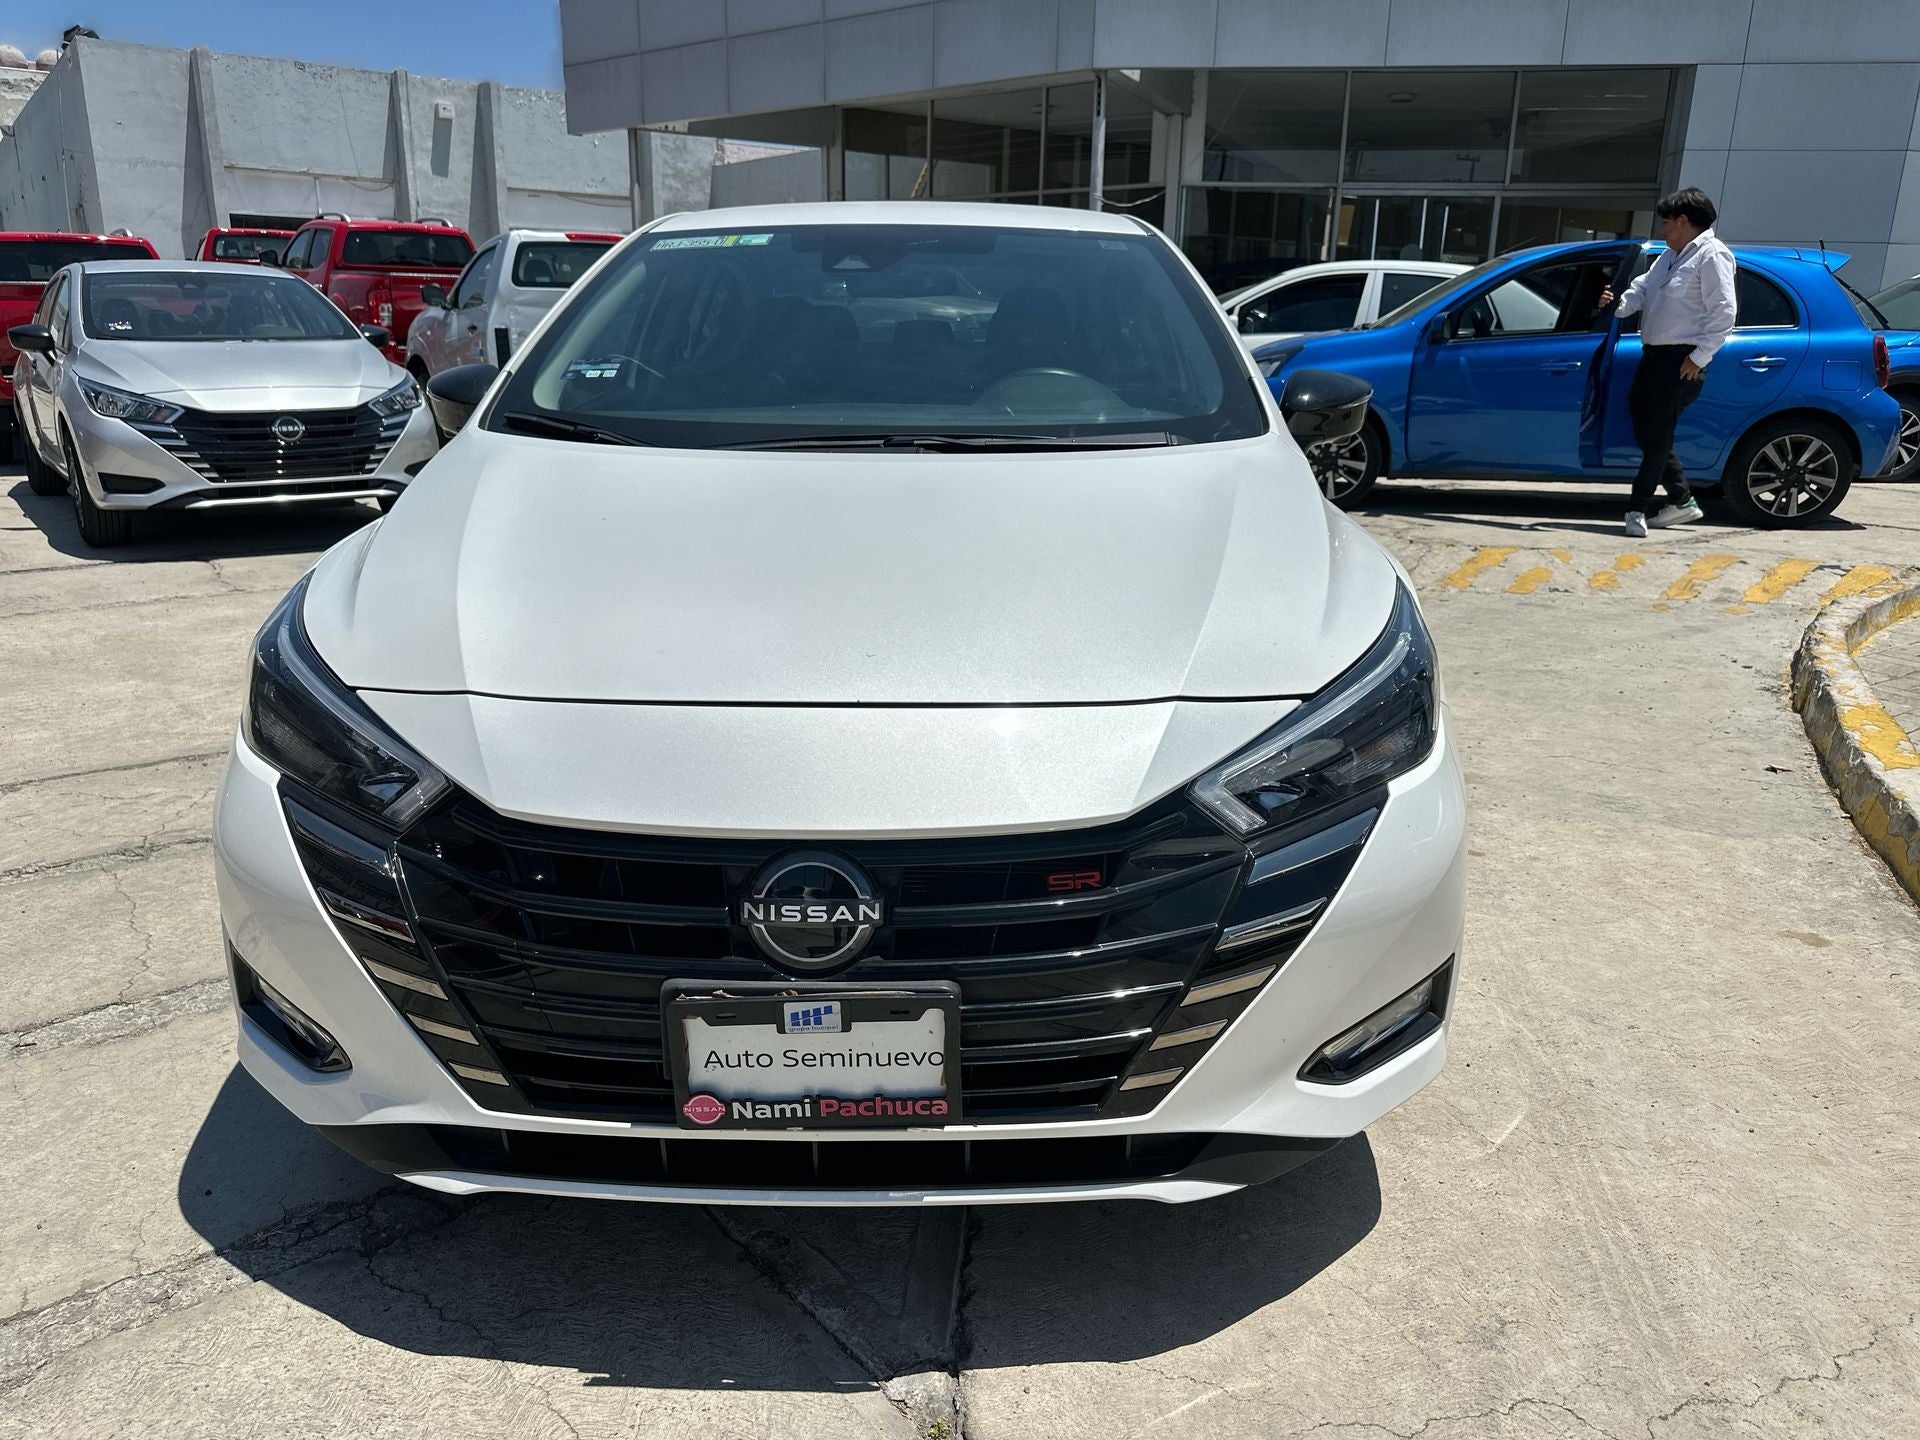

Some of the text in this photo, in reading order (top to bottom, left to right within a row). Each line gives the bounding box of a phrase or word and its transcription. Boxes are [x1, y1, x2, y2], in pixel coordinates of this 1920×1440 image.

[1047, 872, 1101, 891] SR
[743, 902, 881, 923] NISSAN
[704, 1048, 945, 1069] Auto Seminuevo
[683, 1105, 725, 1113] NISSAN
[732, 1096, 950, 1120] Nami Pachuca
